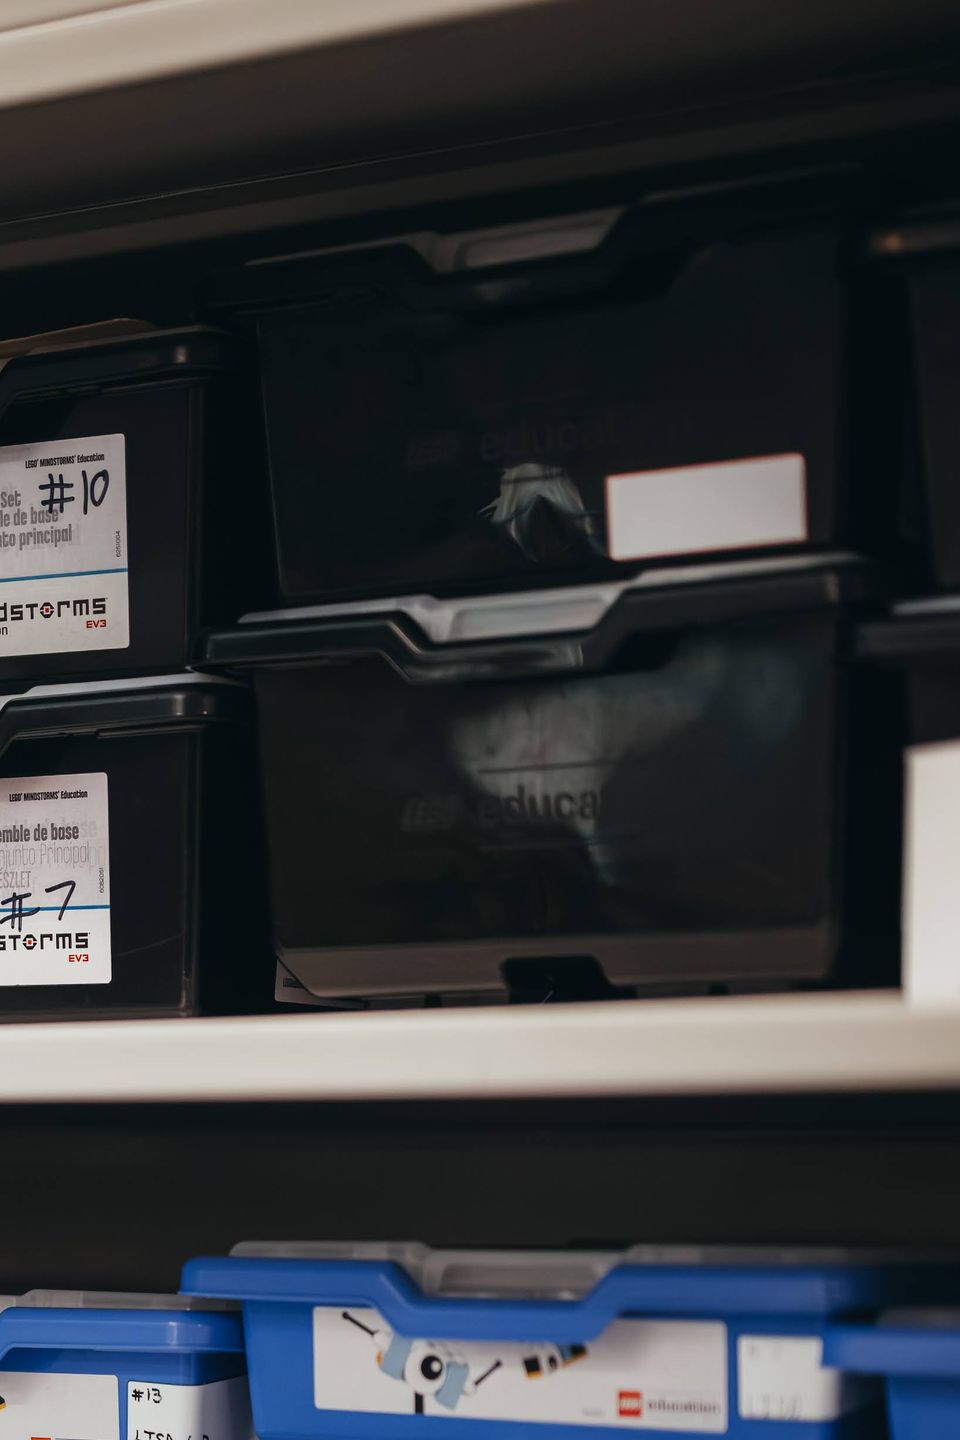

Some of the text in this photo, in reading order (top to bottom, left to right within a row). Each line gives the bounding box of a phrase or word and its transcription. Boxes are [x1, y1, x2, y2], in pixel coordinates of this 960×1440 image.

[77, 452, 105, 463] Education
[0, 491, 21, 508] Set
[39, 469, 110, 515] #10
[13, 508, 27, 525] de
[30, 507, 59, 524] base
[19, 524, 72, 550] principal
[86, 619, 107, 629] EV3
[60, 789, 88, 799] Education
[33, 823, 48, 841] de
[50, 822, 80, 840] base
[68, 954, 89, 962] EV3
